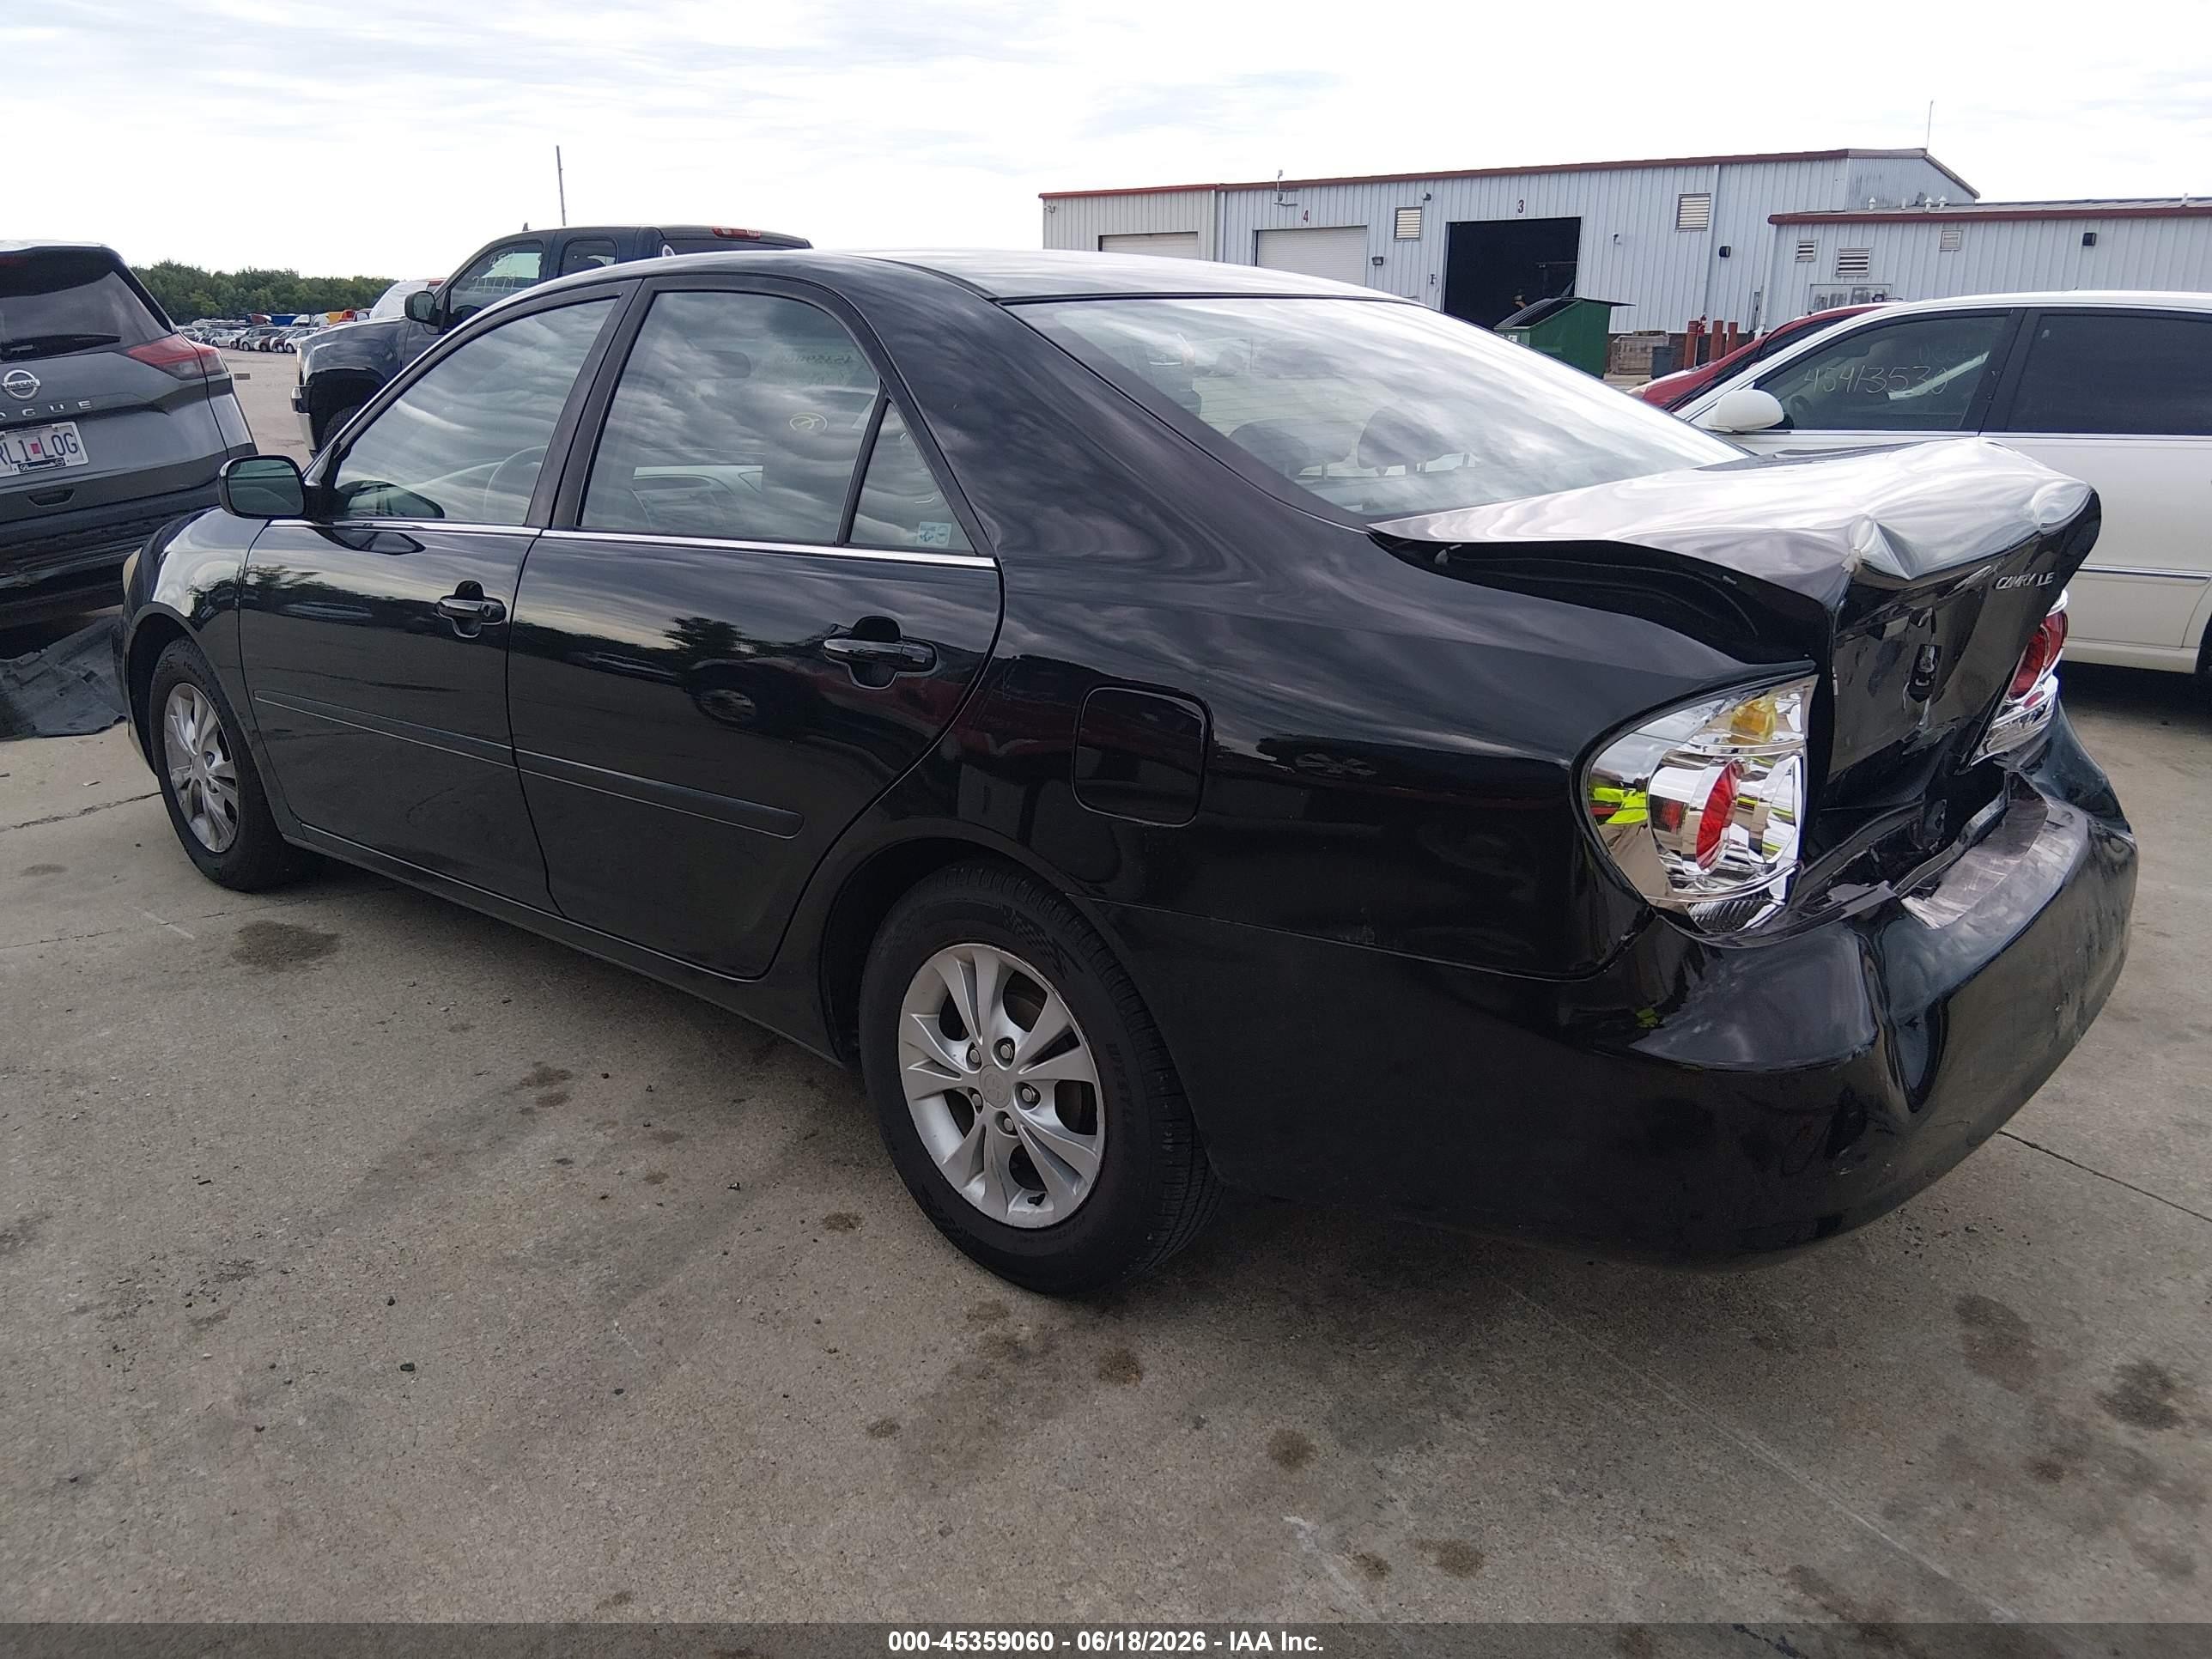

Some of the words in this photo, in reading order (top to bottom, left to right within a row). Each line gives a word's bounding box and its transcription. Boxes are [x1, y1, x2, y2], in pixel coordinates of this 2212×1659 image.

[1517, 199, 1524, 213] 3
[1303, 210, 1309, 222] 4
[7, 380, 37, 390] NISSAN
[2035, 572, 2055, 586] LE
